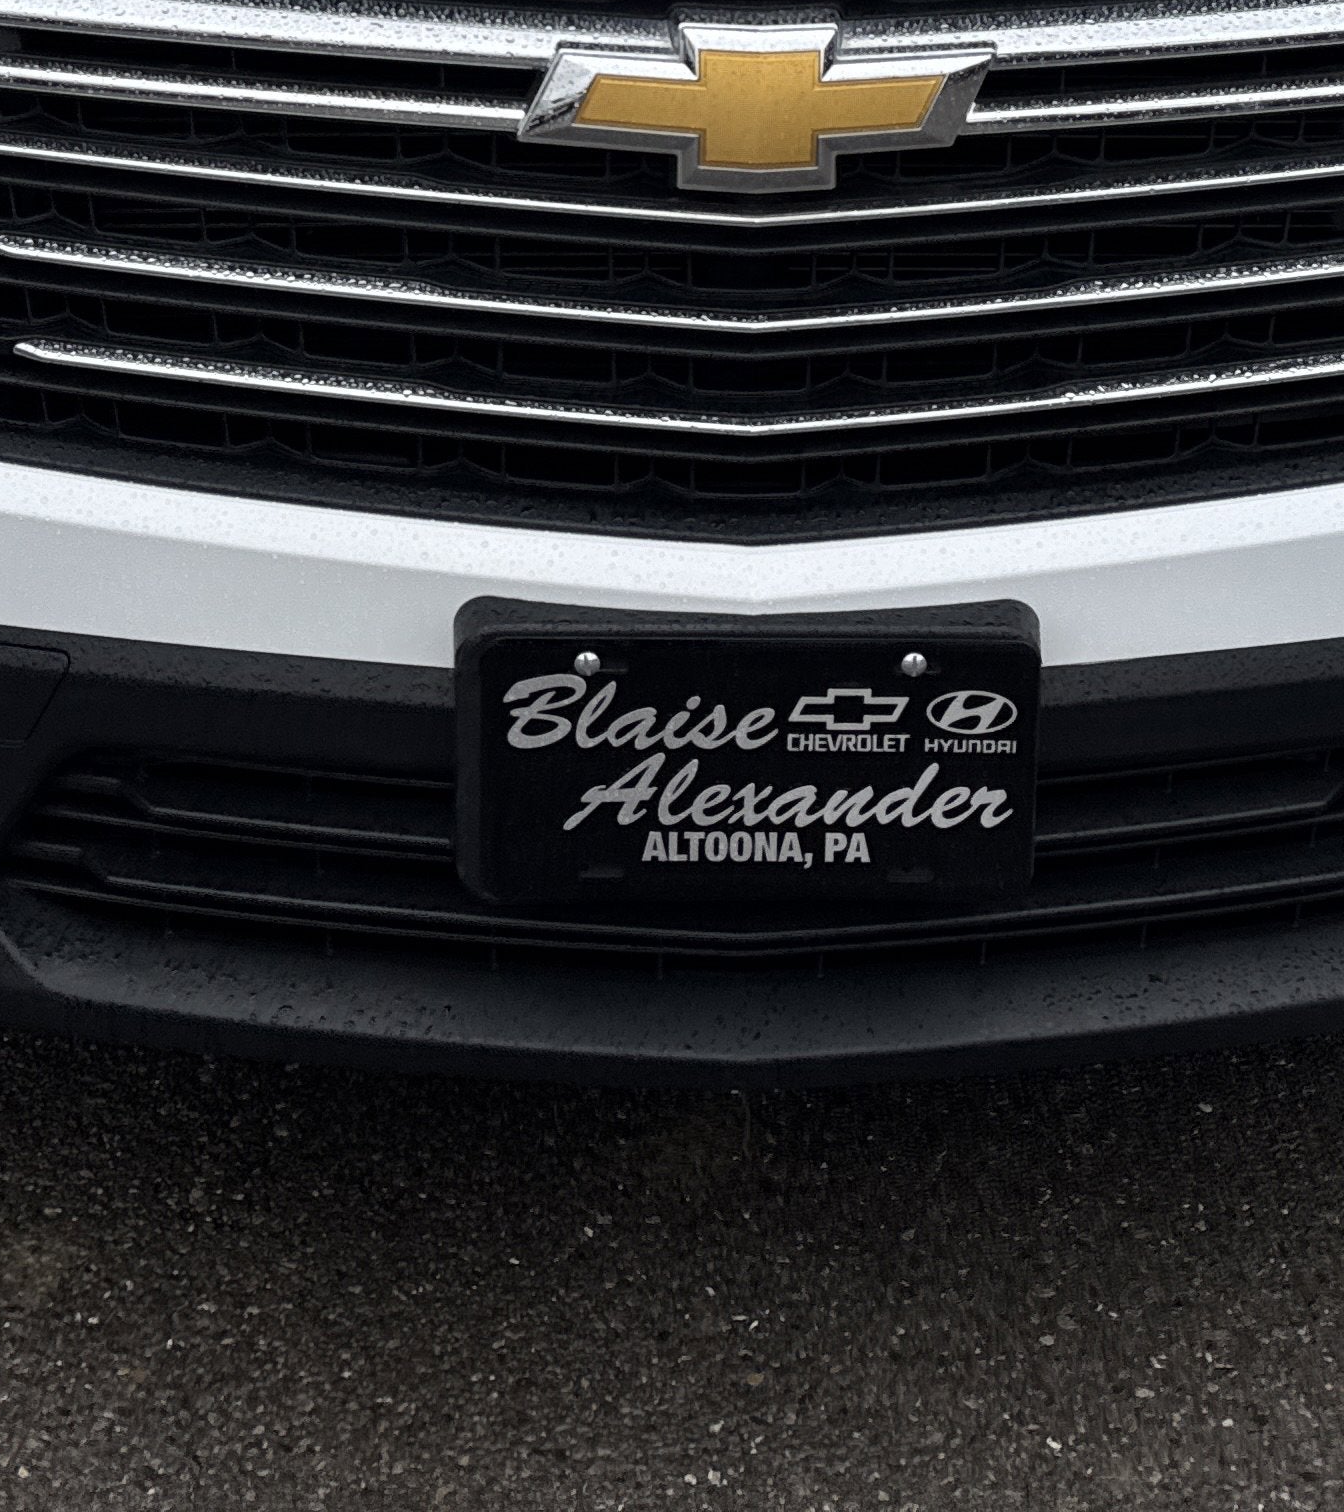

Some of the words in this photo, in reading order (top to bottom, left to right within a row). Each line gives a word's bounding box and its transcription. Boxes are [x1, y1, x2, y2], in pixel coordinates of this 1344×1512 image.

[503, 673, 779, 751] Blaise
[786, 733, 911, 753] CHEVROLET
[924, 738, 1017, 755] HYUNDAI
[563, 752, 1014, 831] Alexander
[641, 830, 814, 869] ALTOONA,
[824, 831, 871, 864] PA
